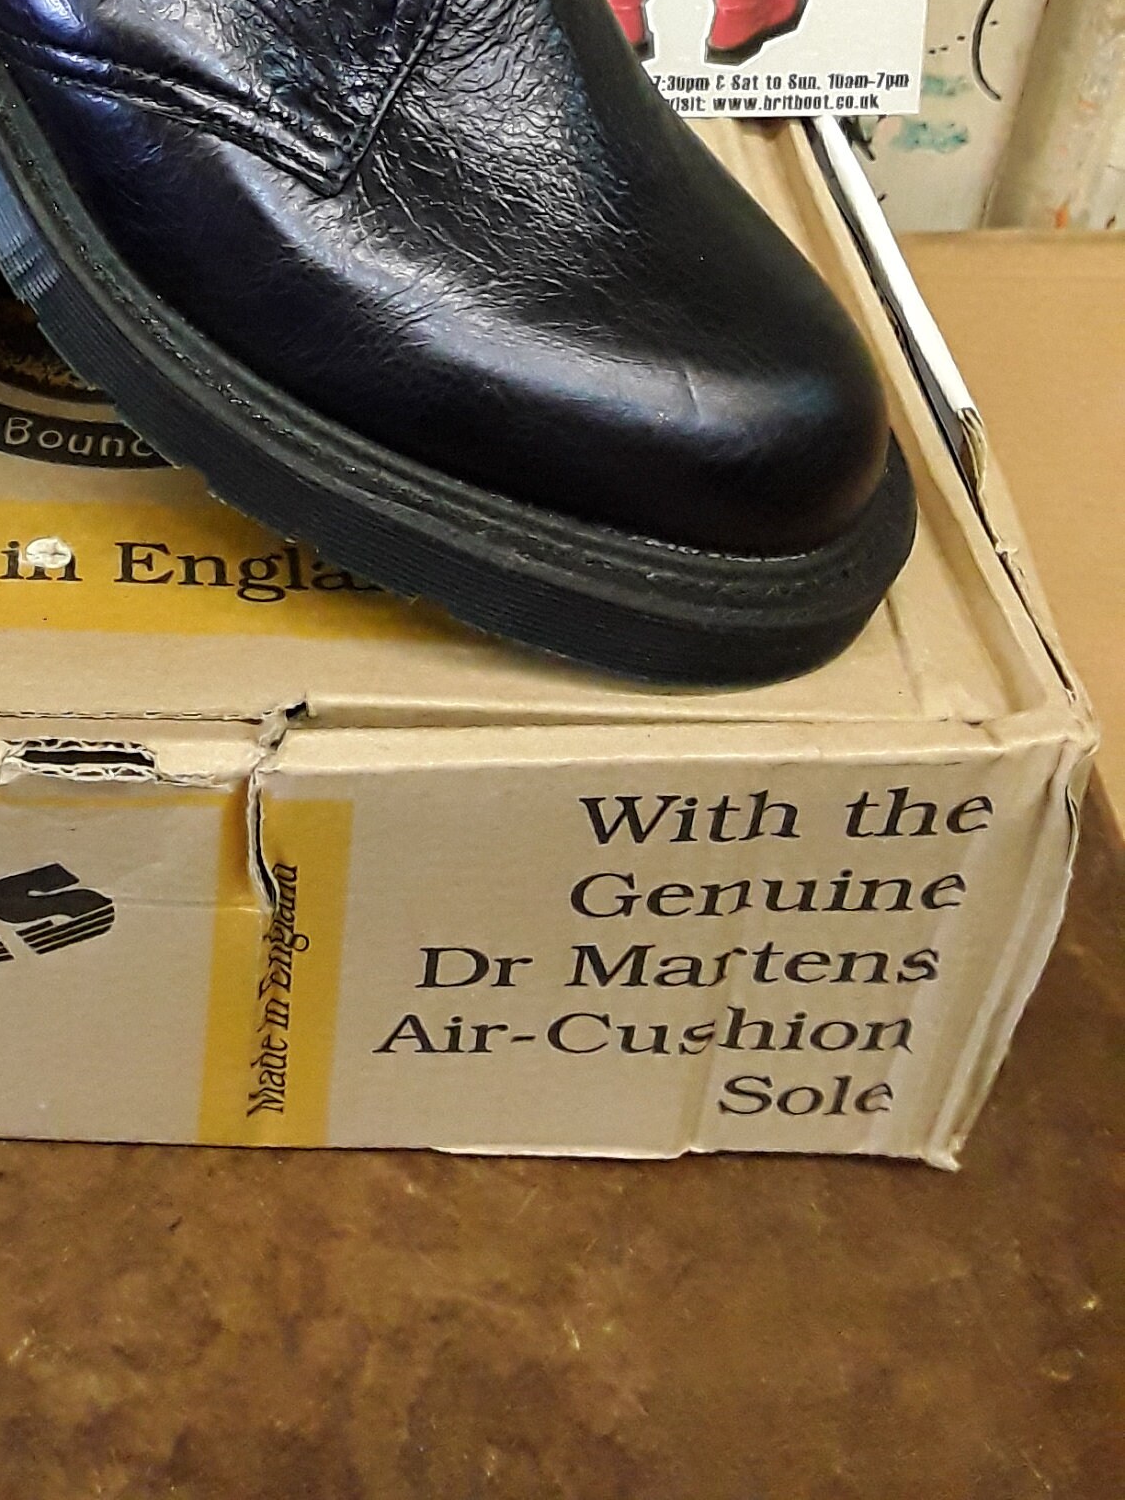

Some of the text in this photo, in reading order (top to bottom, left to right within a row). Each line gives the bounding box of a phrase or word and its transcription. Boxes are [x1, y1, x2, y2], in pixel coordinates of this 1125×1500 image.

[712, 93, 880, 112] www.britboot.co.uk
[731, 74, 759, 91] Sat
[765, 74, 782, 90] to
[787, 73, 822, 91] Sun.
[828, 72, 910, 91] 10am-7pm
[3, 415, 155, 458] Bounc
[113, 540, 385, 604] Engla
[577, 784, 995, 847] With the
[568, 866, 968, 920] Genuine
[413, 940, 942, 990] Dr Martens
[256, 997, 291, 1032] in
[369, 1006, 915, 1059] Air-Cushion
[245, 1033, 289, 1118] Made
[715, 1073, 897, 1119] Sole
